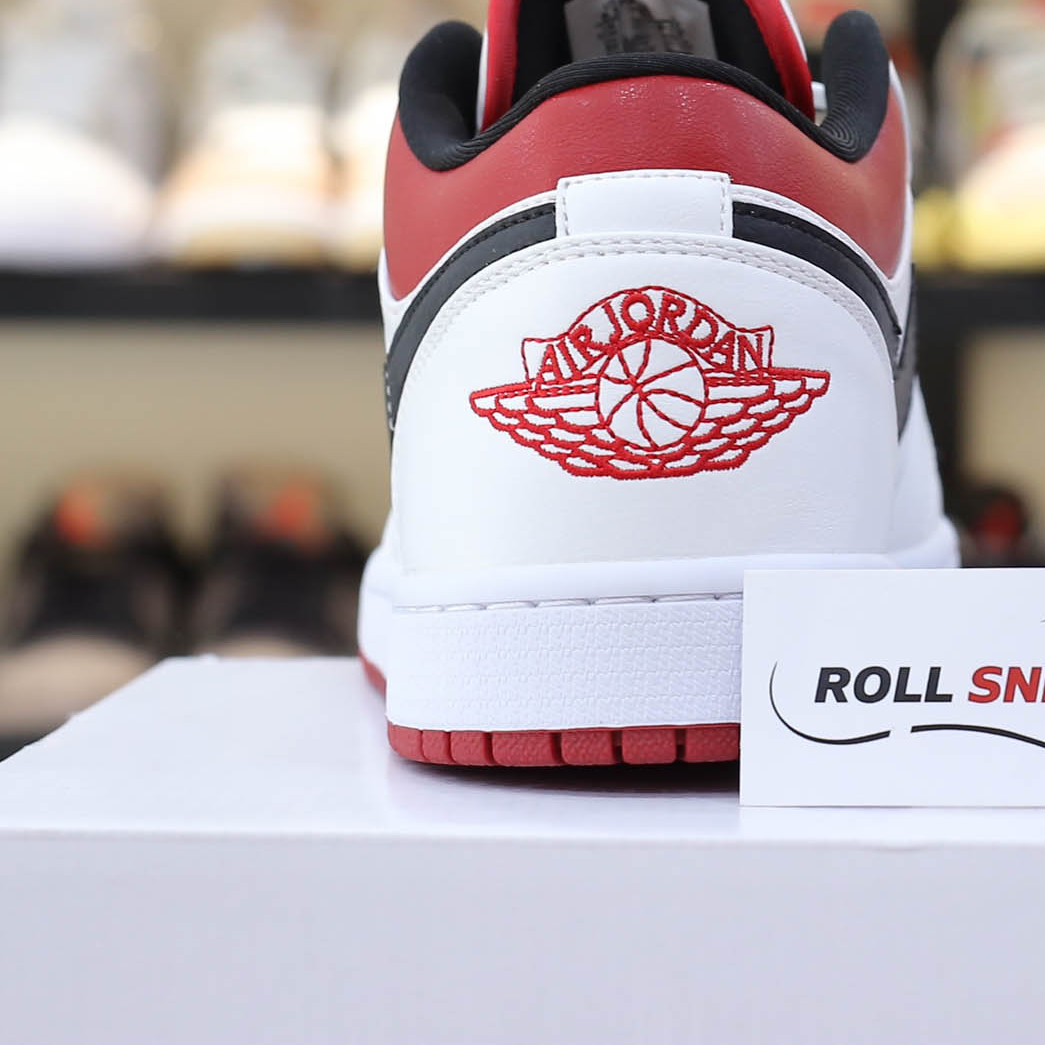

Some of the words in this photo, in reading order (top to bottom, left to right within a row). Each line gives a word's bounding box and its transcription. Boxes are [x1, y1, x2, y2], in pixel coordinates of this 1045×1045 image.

[537, 325, 612, 382] AIR
[603, 292, 764, 370] JORDAN
[815, 666, 953, 703] ROLL
